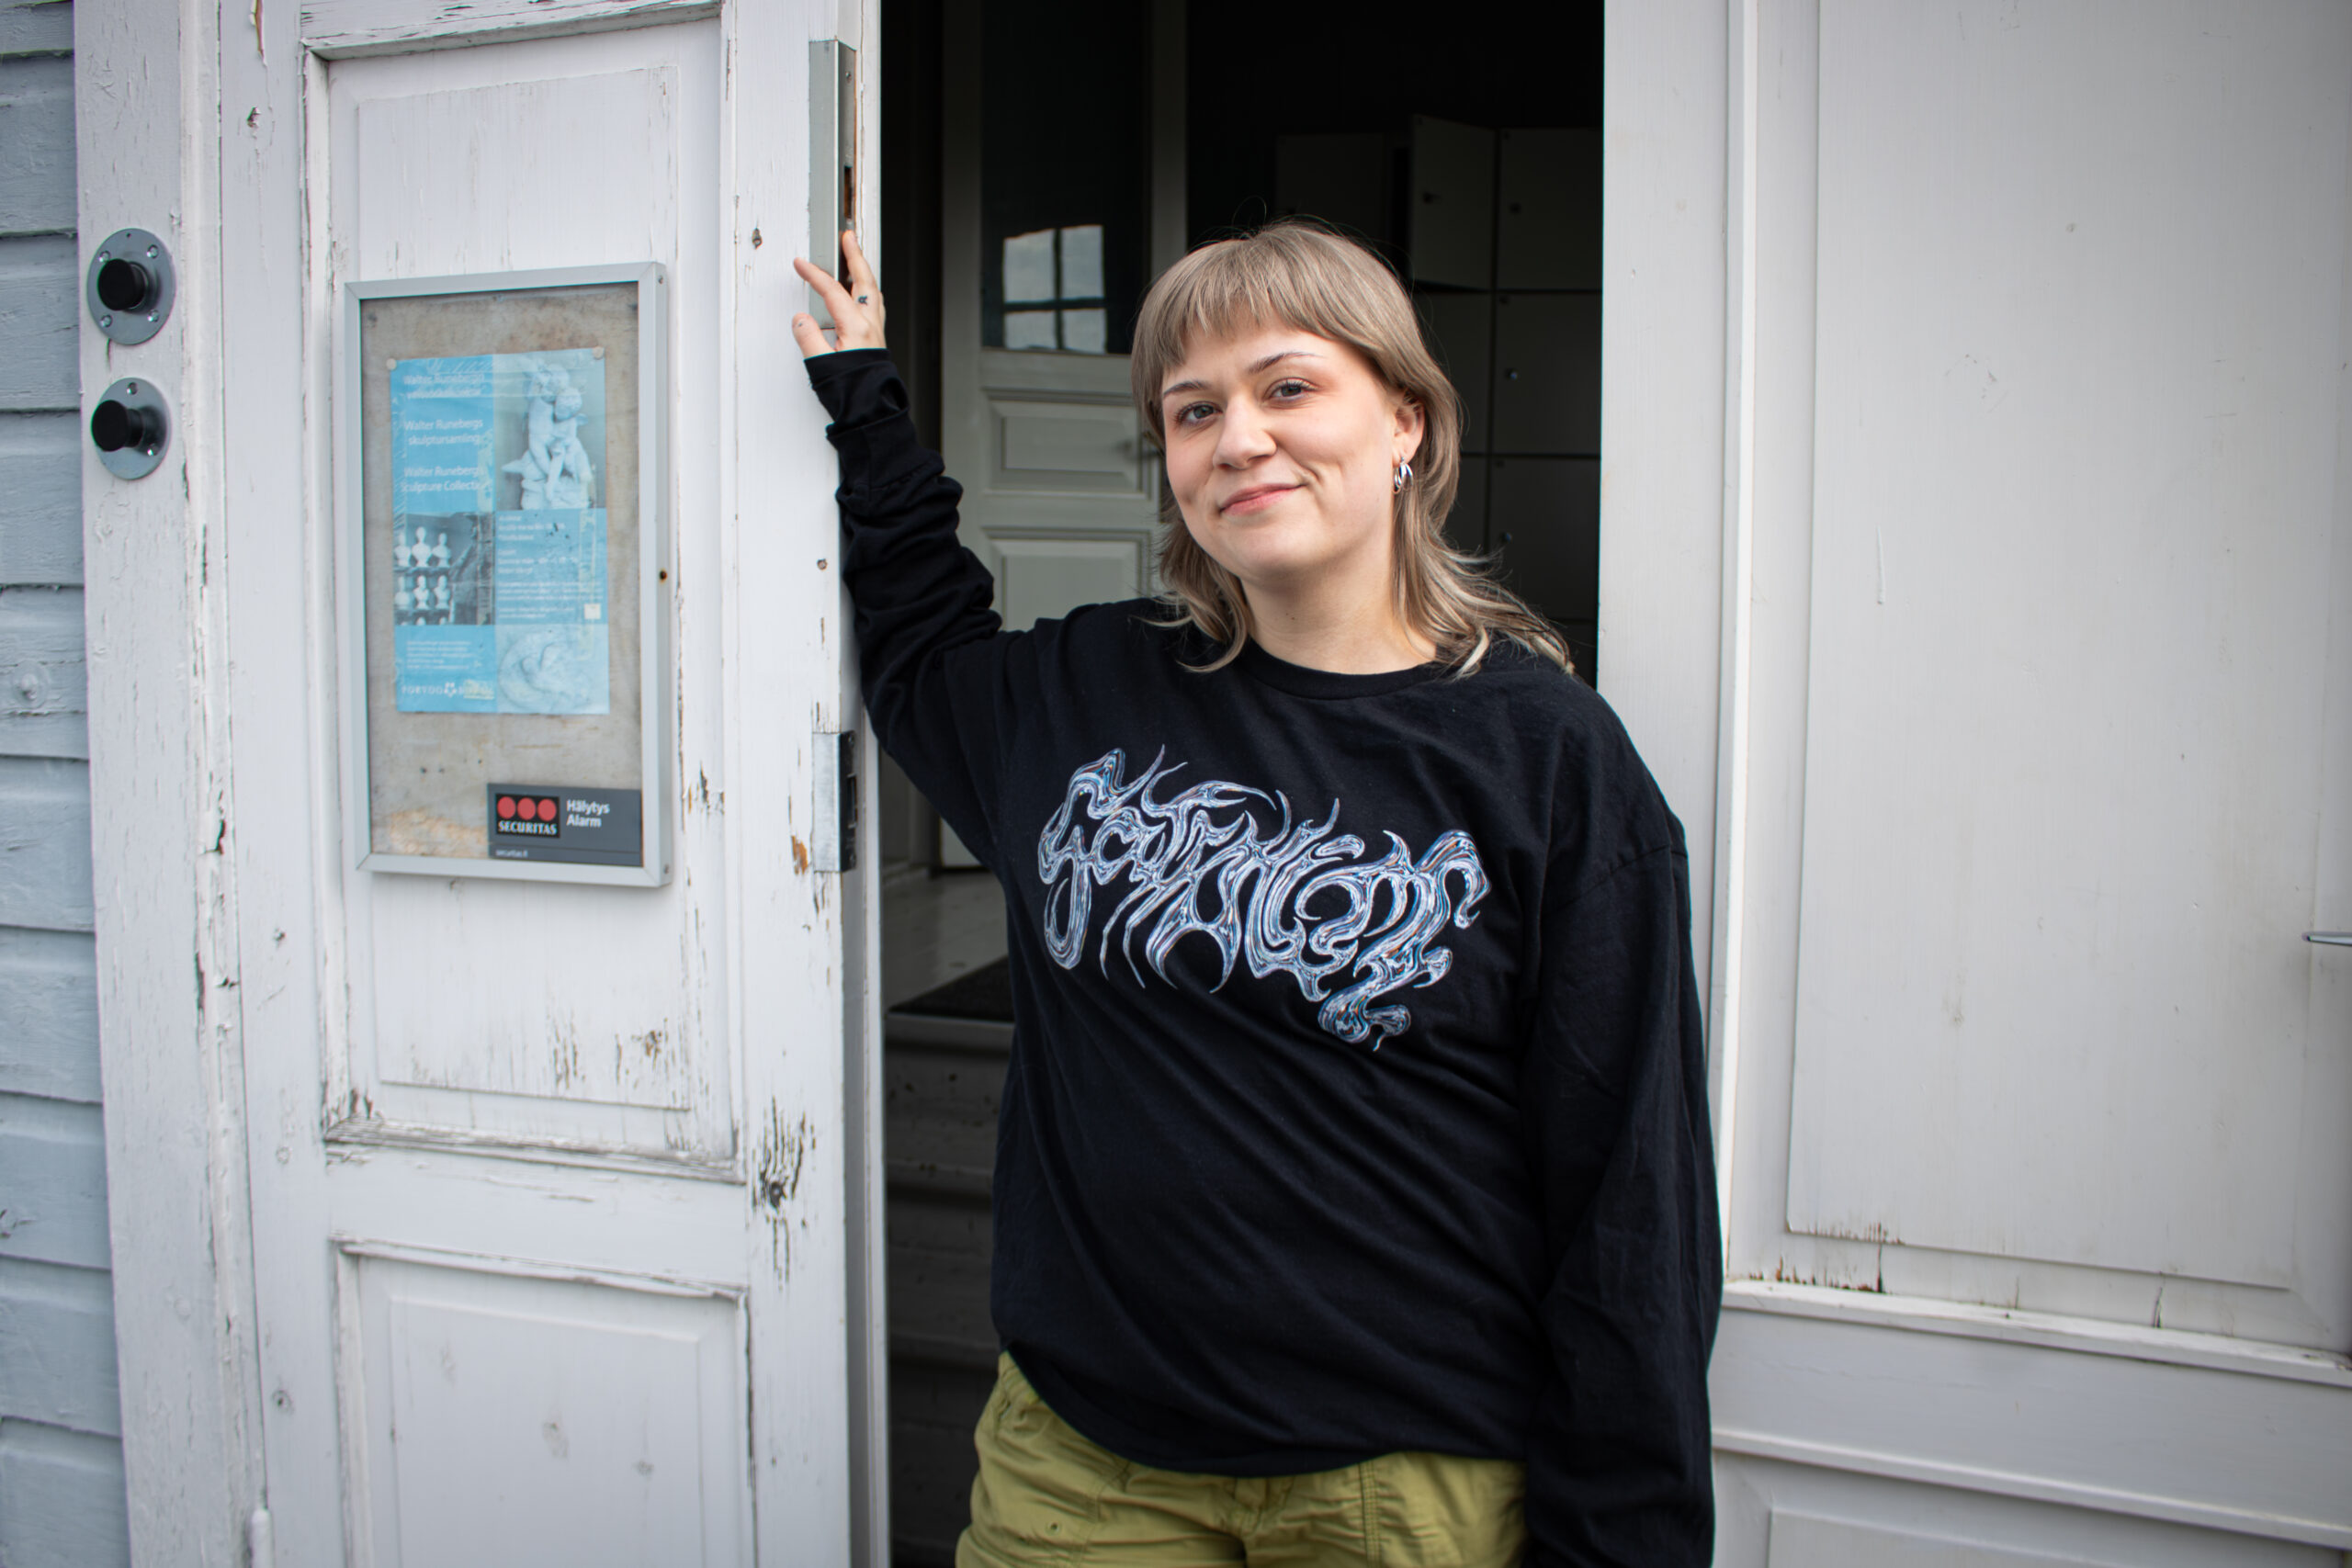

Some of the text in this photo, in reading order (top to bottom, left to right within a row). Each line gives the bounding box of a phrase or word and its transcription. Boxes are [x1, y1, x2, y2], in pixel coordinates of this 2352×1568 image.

[404, 418, 483, 431] Walter Runebergs
[404, 467, 434, 478] Walter
[566, 798, 611, 815] Hälytys
[498, 820, 558, 835] SECURITAS
[566, 814, 602, 828] Alarm
